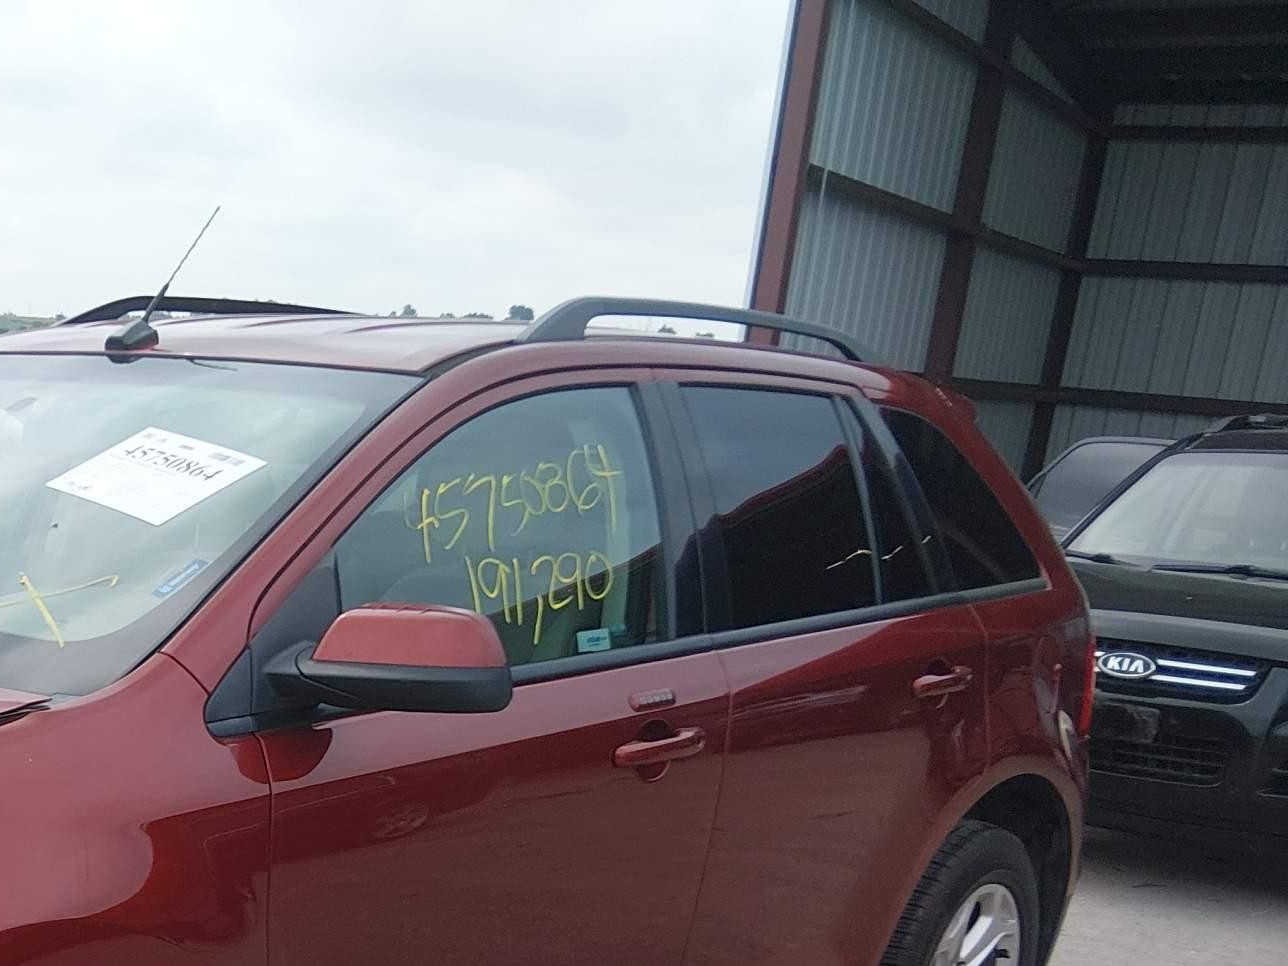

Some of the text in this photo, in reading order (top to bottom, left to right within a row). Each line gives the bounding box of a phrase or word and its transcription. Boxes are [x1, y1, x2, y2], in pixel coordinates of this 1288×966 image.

[124, 444, 224, 481] 45750864
[403, 443, 623, 563] 45750864
[1107, 655, 1145, 674] KIA
